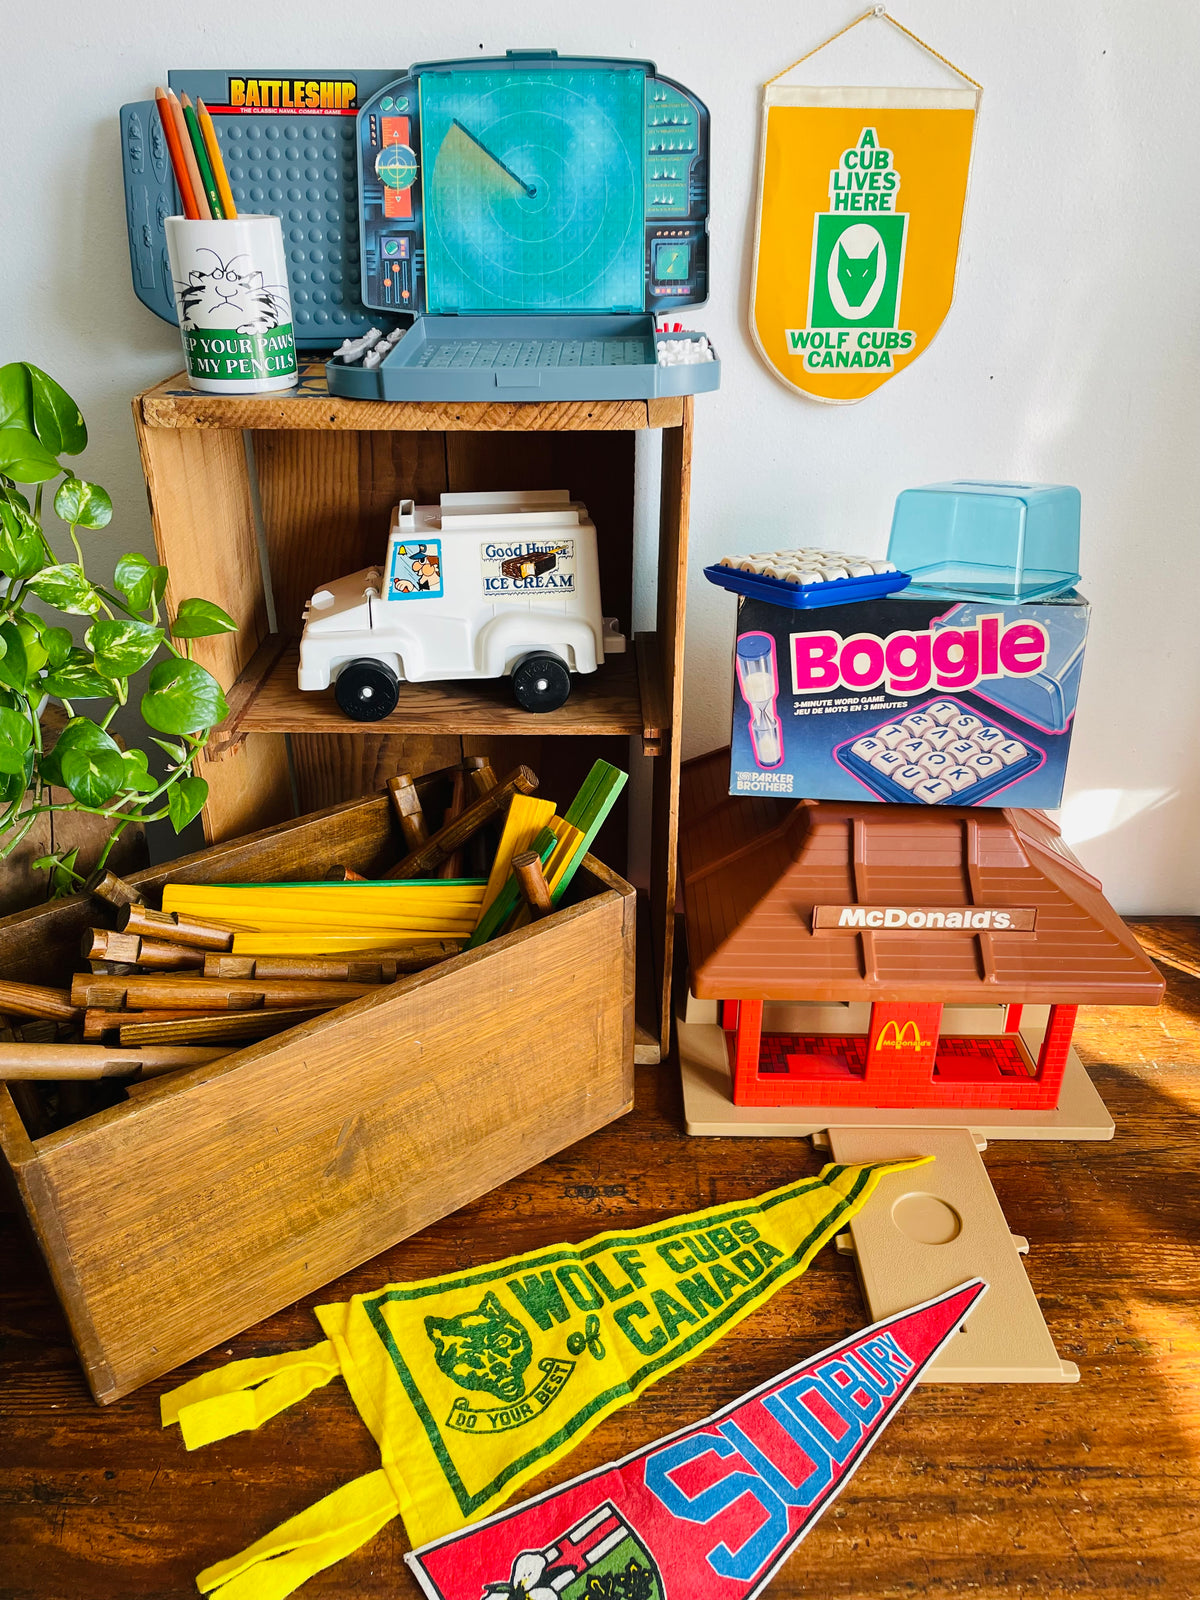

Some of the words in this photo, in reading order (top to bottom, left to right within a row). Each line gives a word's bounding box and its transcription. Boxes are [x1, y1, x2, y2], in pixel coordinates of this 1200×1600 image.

[230, 79, 356, 108] BATTLESHIP
[860, 129, 875, 148] A
[844, 150, 889, 170] CUB
[833, 171, 896, 191] LIVES
[834, 192, 892, 211] HERE
[200, 338, 253, 354] YOUR
[256, 332, 293, 352] PAWS
[790, 331, 850, 349] WOLF
[857, 331, 912, 349] CUBS
[197, 358, 221, 373] MY
[226, 352, 294, 373] PENCILS
[807, 350, 891, 368] CANADA
[485, 544, 522, 558] Good
[484, 578, 509, 590] ICE
[513, 575, 573, 589] CREAM
[791, 615, 1048, 694] Boggle
[793, 699, 833, 708] 3-MINUTE
[834, 698, 859, 706] WORD
[861, 695, 885, 703] GAME
[794, 707, 811, 716] JEU
[824, 705, 848, 714] MOTS
[850, 704, 862, 712] EN
[870, 701, 908, 711] MINUTES
[737, 781, 794, 792] BROTHERS
[751, 772, 794, 783] PARKER
[505, 1249, 647, 1332] WOLF
[655, 1219, 761, 1274] CUBS
[613, 1240, 785, 1356] CANADA
[566, 1313, 606, 1361] of
[455, 1413, 477, 1428] DO
[486, 1403, 534, 1429] YOUR
[534, 1365, 570, 1405] BEST
[644, 1331, 916, 1582] SUDBURY
